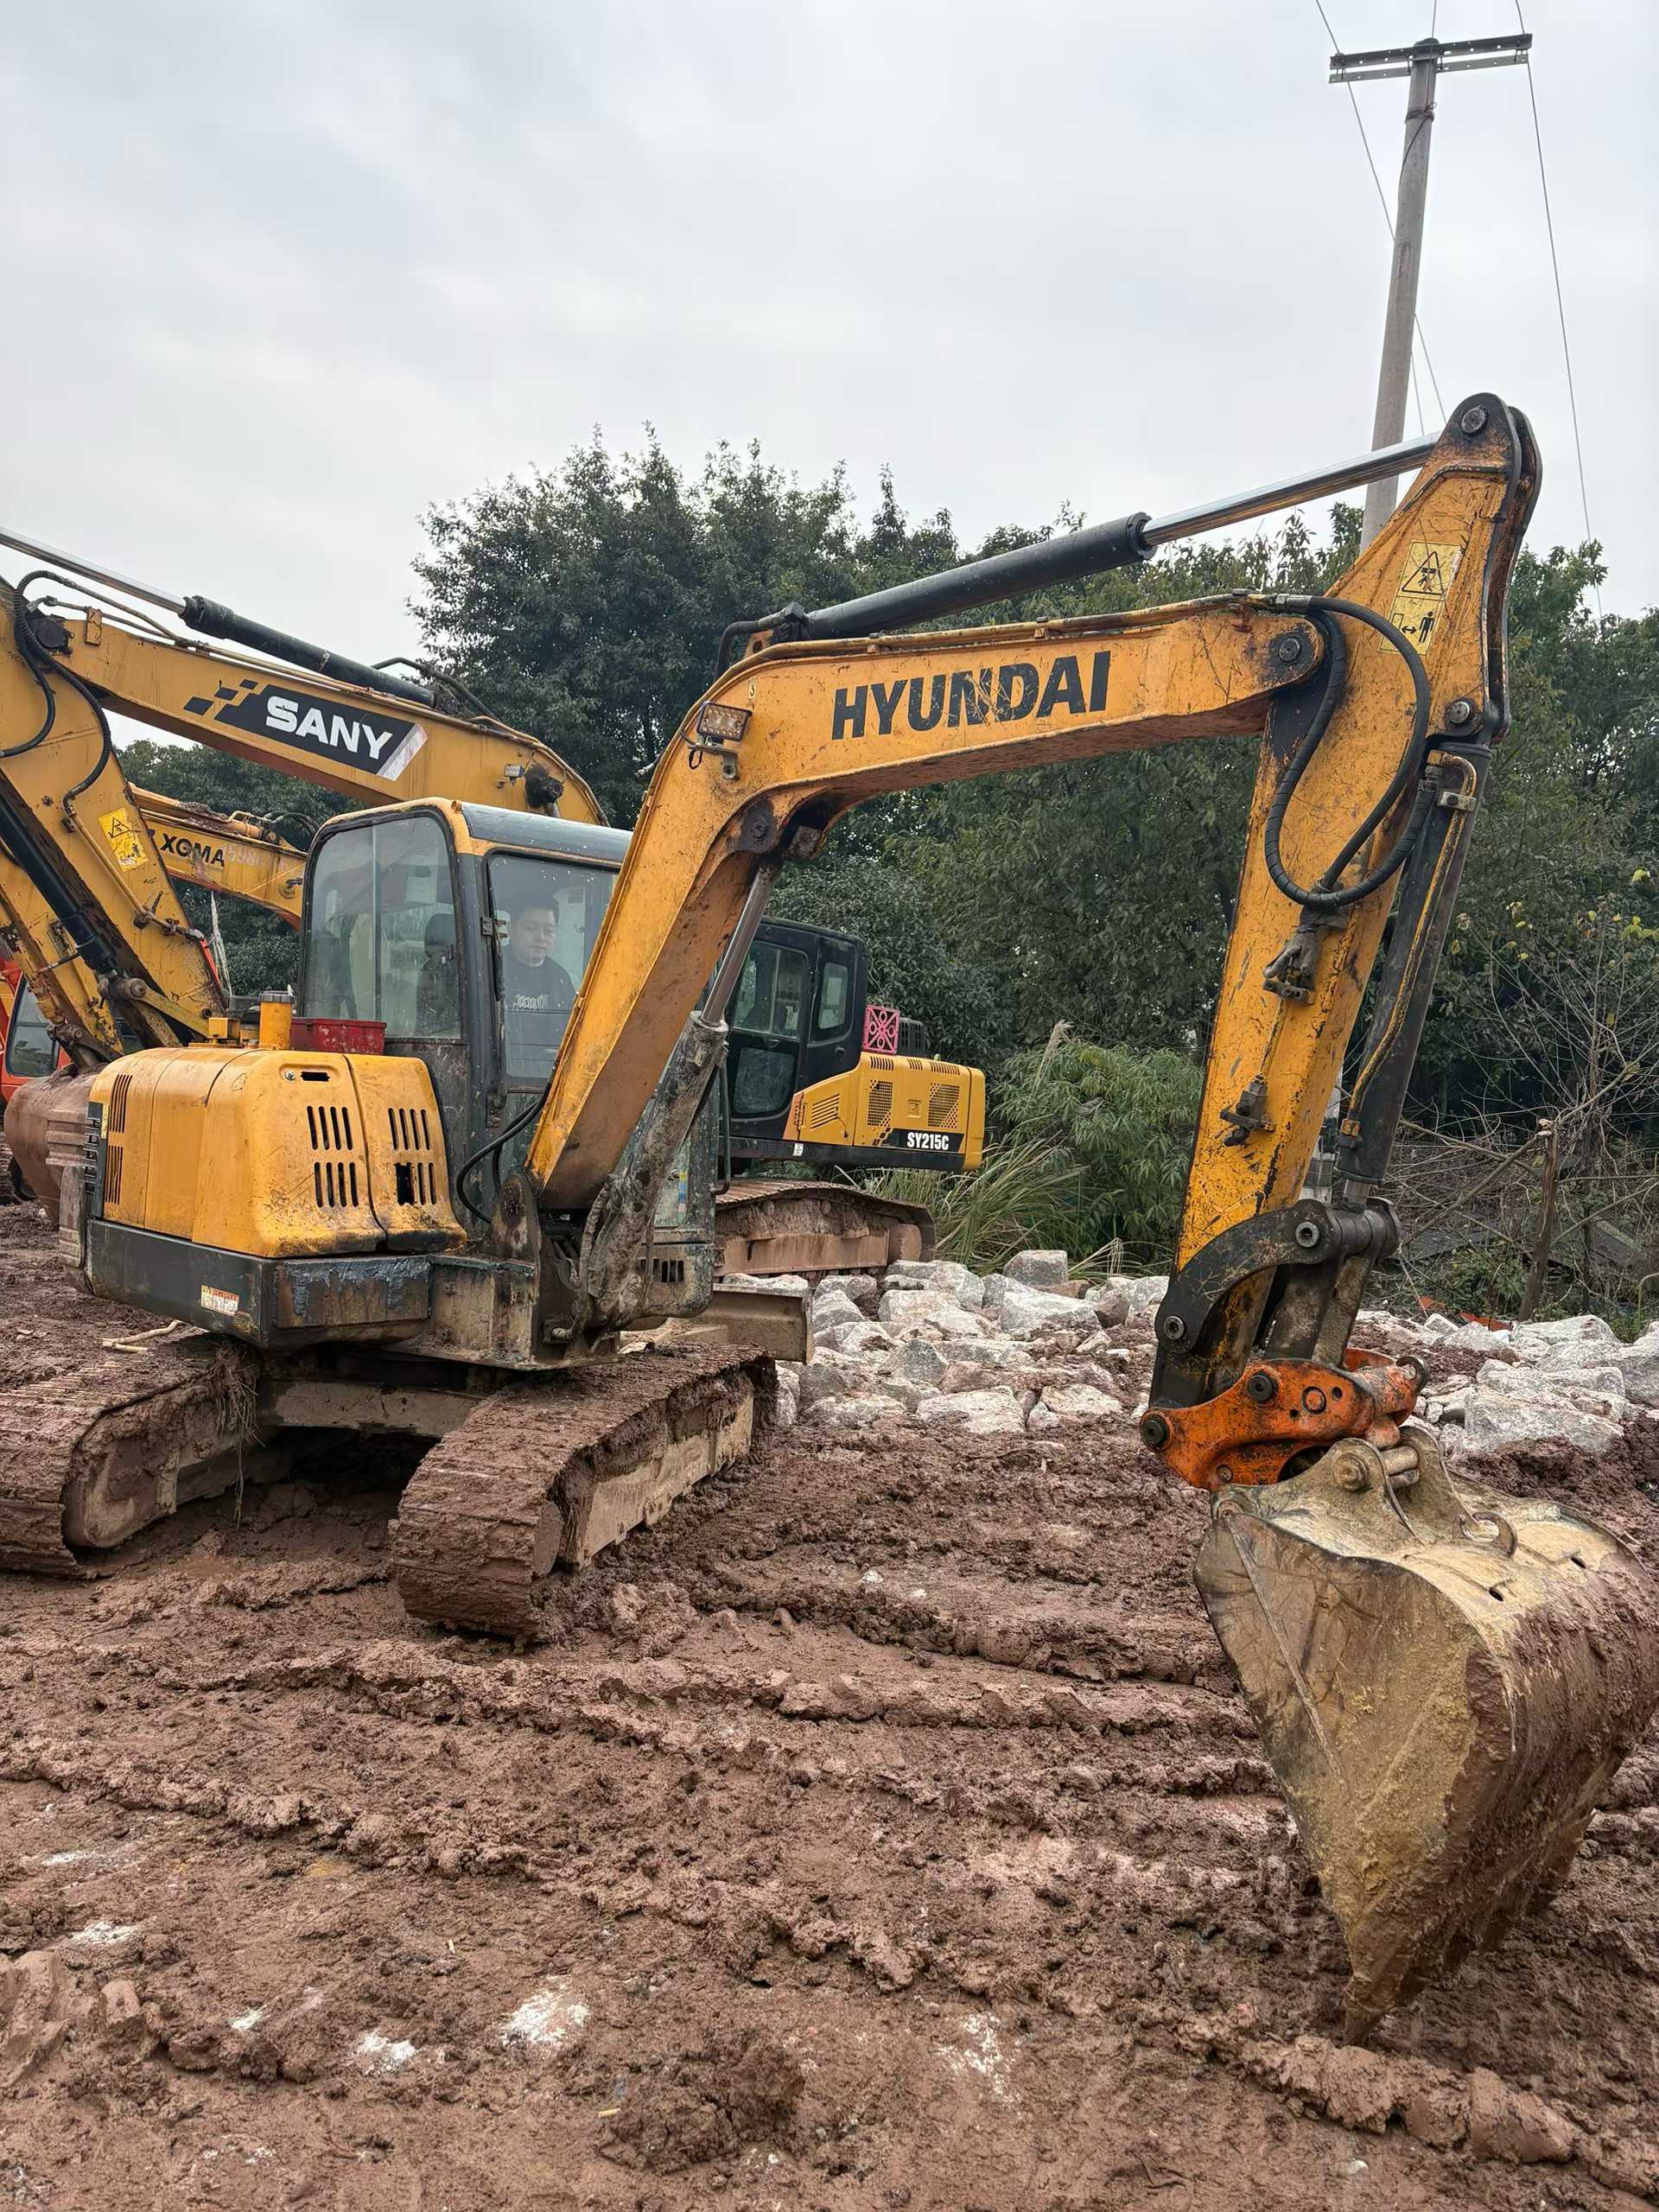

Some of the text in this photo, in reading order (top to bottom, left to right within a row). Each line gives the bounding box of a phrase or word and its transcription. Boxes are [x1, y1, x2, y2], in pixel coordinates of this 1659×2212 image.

[265, 695, 394, 760] SANY
[831, 650, 1111, 741] HYUNDAI
[906, 1131, 950, 1151] SY215C
